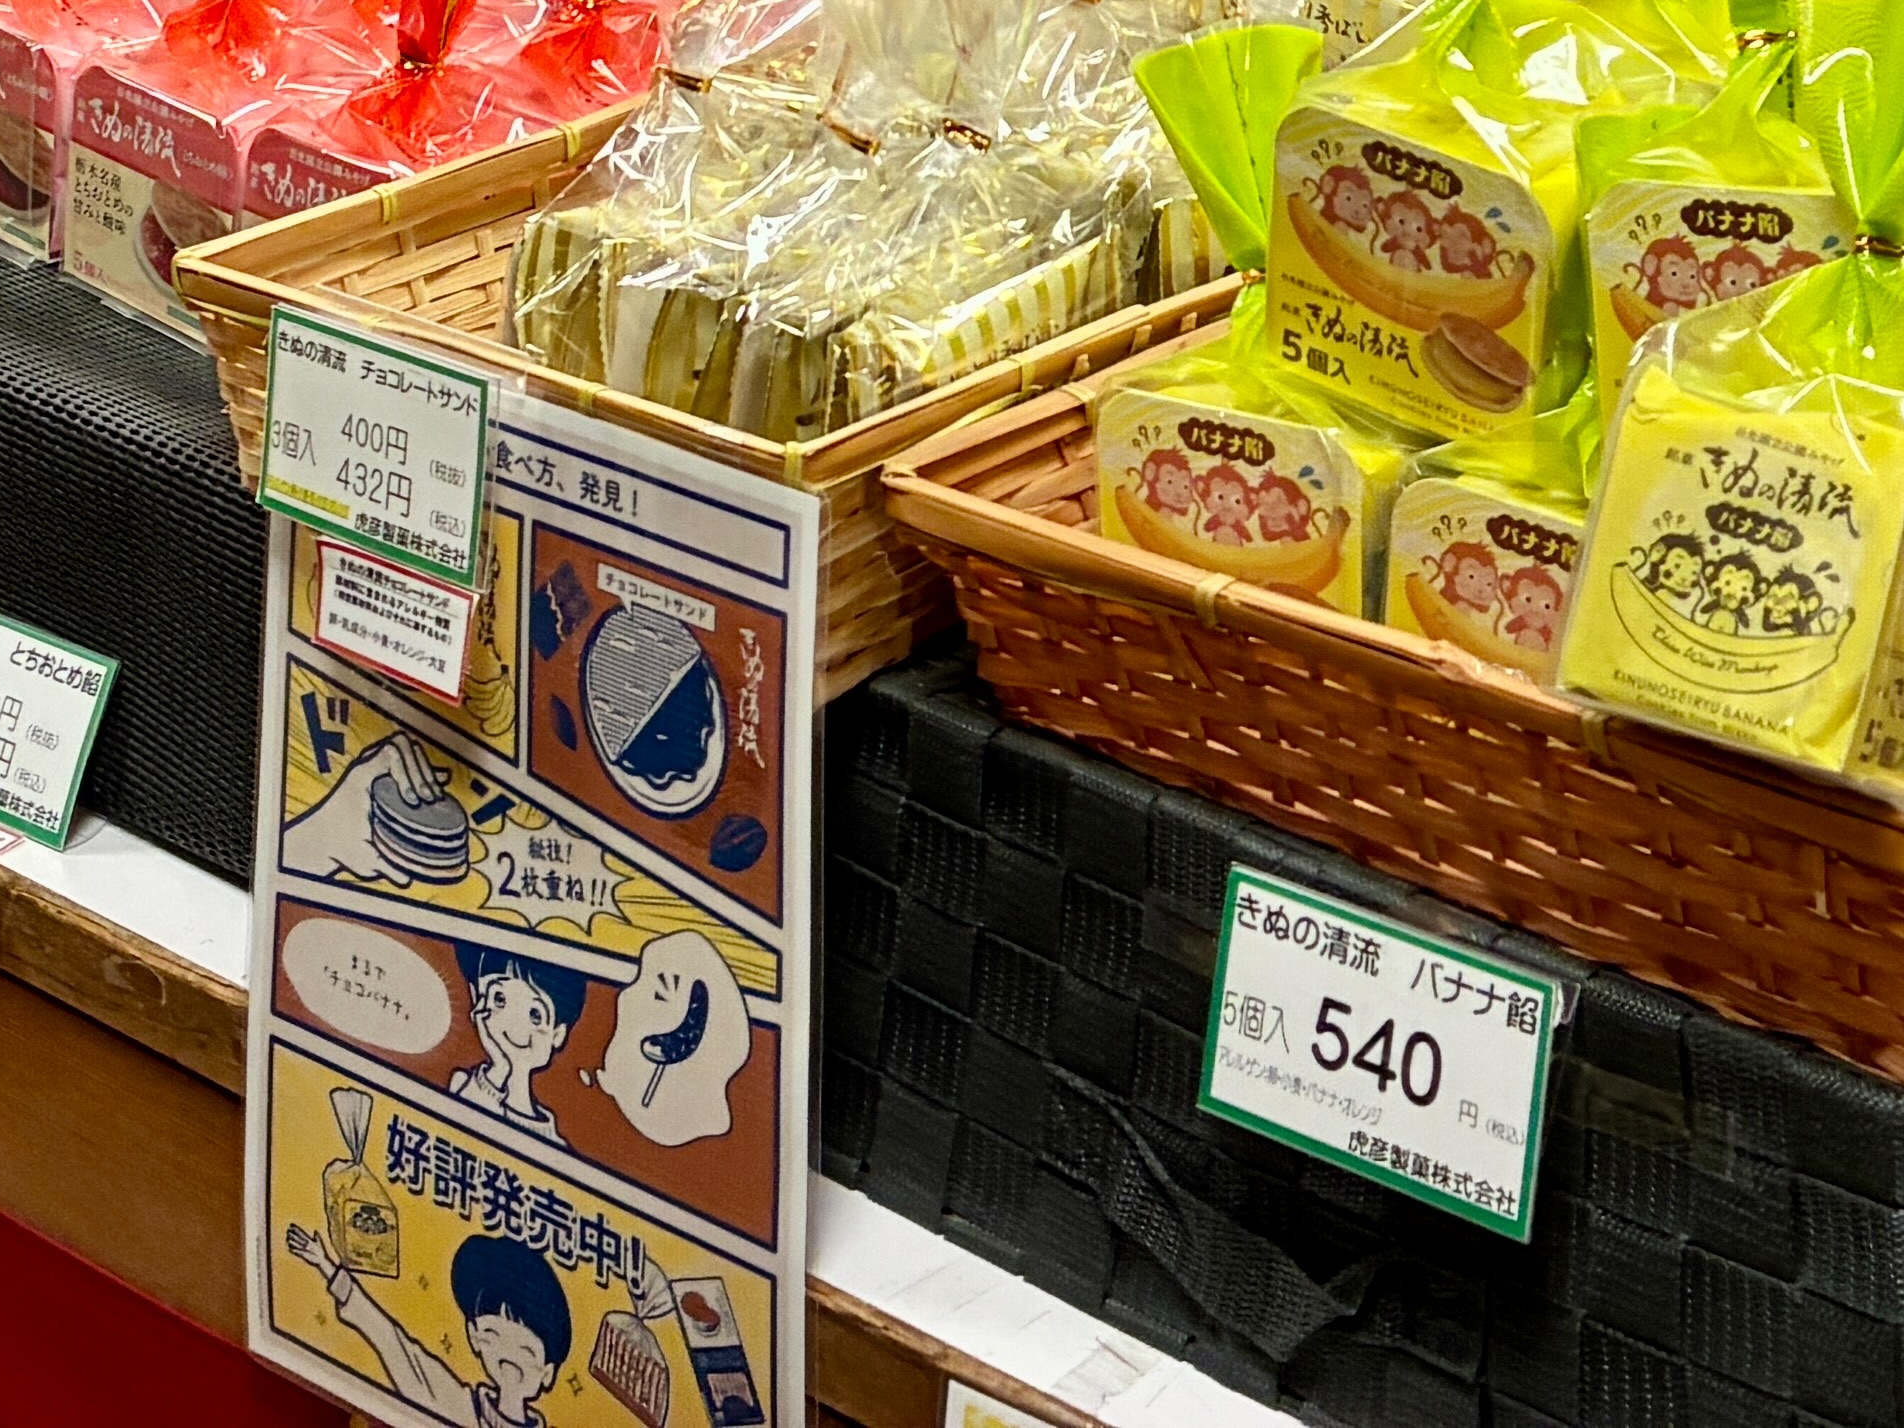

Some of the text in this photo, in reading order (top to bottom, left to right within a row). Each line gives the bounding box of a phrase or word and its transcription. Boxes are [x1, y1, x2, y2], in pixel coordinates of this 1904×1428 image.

[277, 329, 479, 417] きぬの清流 チョコレートサンド
[1280, 327, 1352, 386] 5個入
[1304, 302, 1420, 379] きぬの清流
[271, 418, 413, 518] 3個入 432円
[340, 412, 409, 467] 400円
[1698, 444, 1862, 540] きぬの清流
[354, 510, 468, 571] 虎彦製菓株式会社
[604, 571, 708, 623] チョコレートサンド
[9, 640, 103, 697] とちおとめ餡
[1235, 892, 1540, 1037] きぬの清流 バナナ餡
[1222, 989, 1291, 1055] 5個入
[1310, 996, 1443, 1109] 540
[1458, 1098, 1480, 1130] 円
[385, 1113, 647, 1301] 好評発売中！
[1347, 1129, 1517, 1218] 虎彦製菓株式会社
